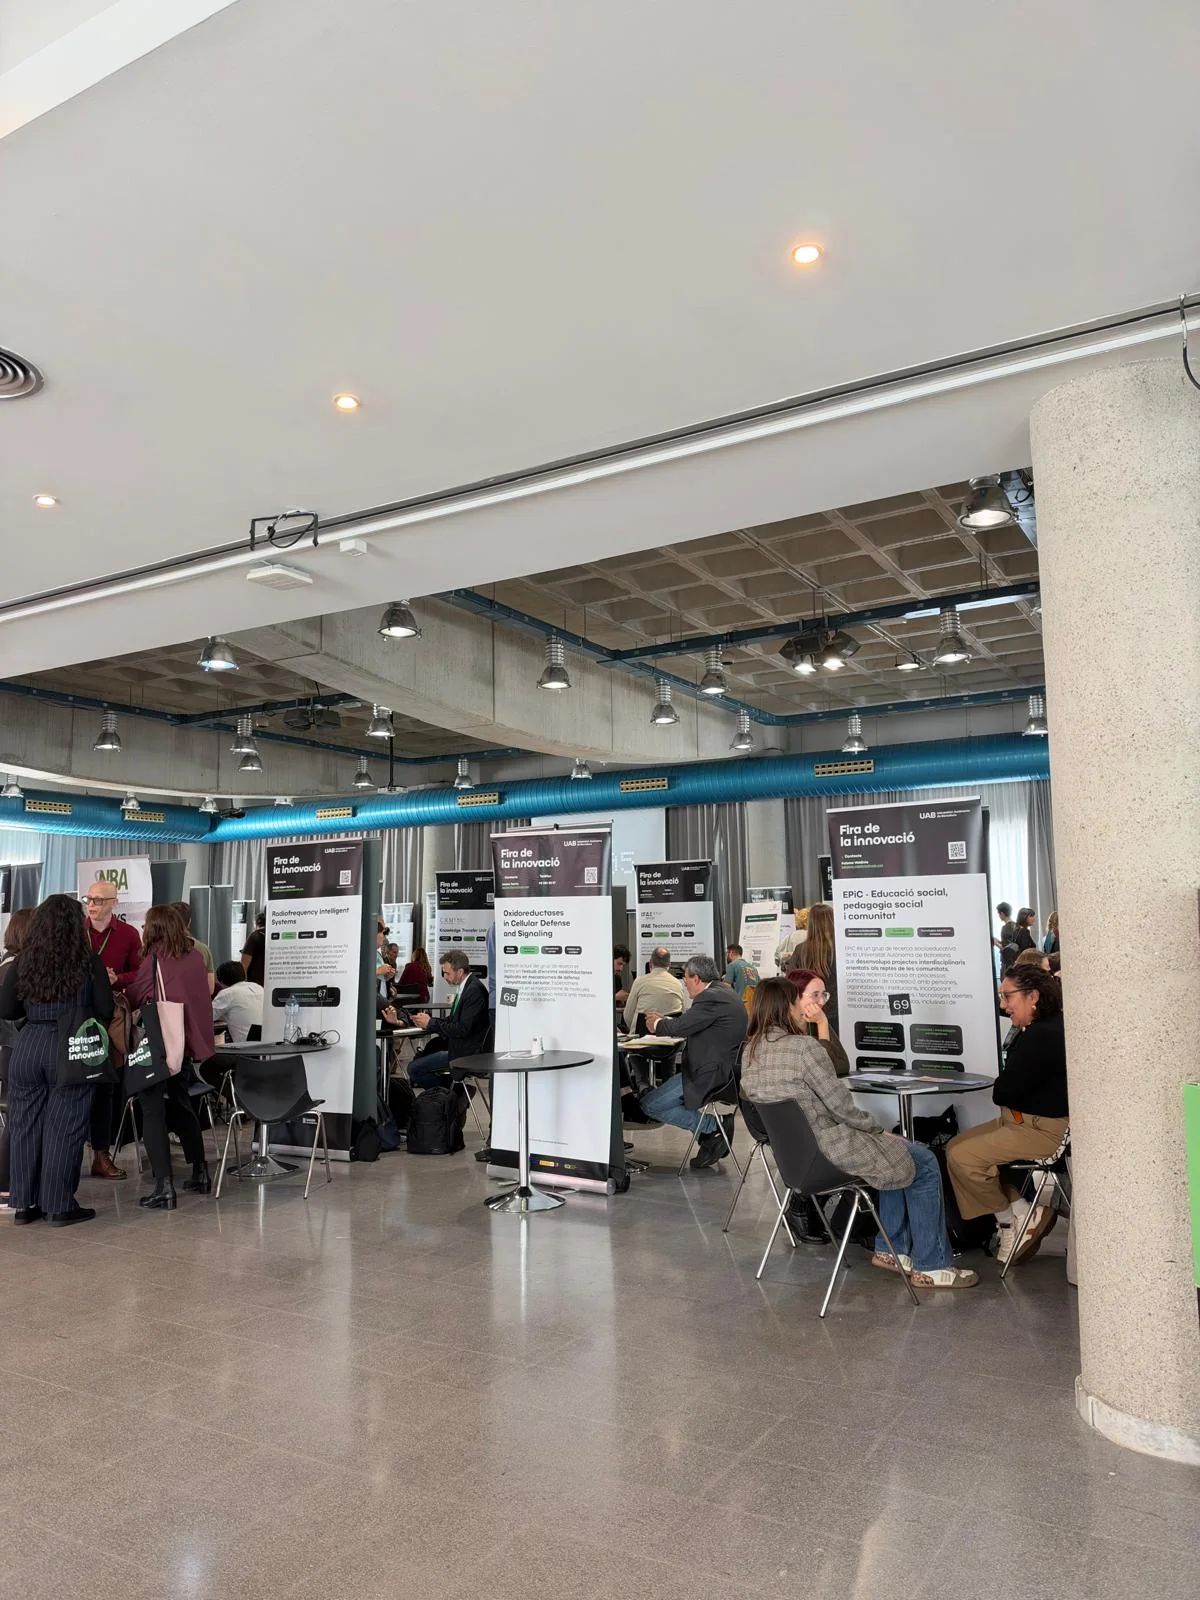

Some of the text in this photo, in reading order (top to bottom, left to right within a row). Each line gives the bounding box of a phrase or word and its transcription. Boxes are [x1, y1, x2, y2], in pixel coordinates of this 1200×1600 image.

[840, 823, 880, 835] Fira de
[841, 832, 915, 846] la innovació
[501, 848, 532, 858] Fira de
[274, 856, 299, 865] Fira de
[502, 858, 560, 869] la innovació
[274, 863, 321, 875] la innovació
[647, 877, 679, 885] innovació
[843, 890, 863, 898] EPiC
[871, 889, 914, 898] Educació
[917, 888, 948, 897] social,
[843, 900, 923, 910] pedagogia social
[319, 907, 349, 916] Intelligent
[848, 912, 896, 920] comunitat
[518, 930, 552, 938] Signaling
[503, 992, 516, 1002] 68
[893, 999, 910, 1010] 69
[68, 1045, 81, 1053] de
[69, 1047, 105, 1061] innovació
